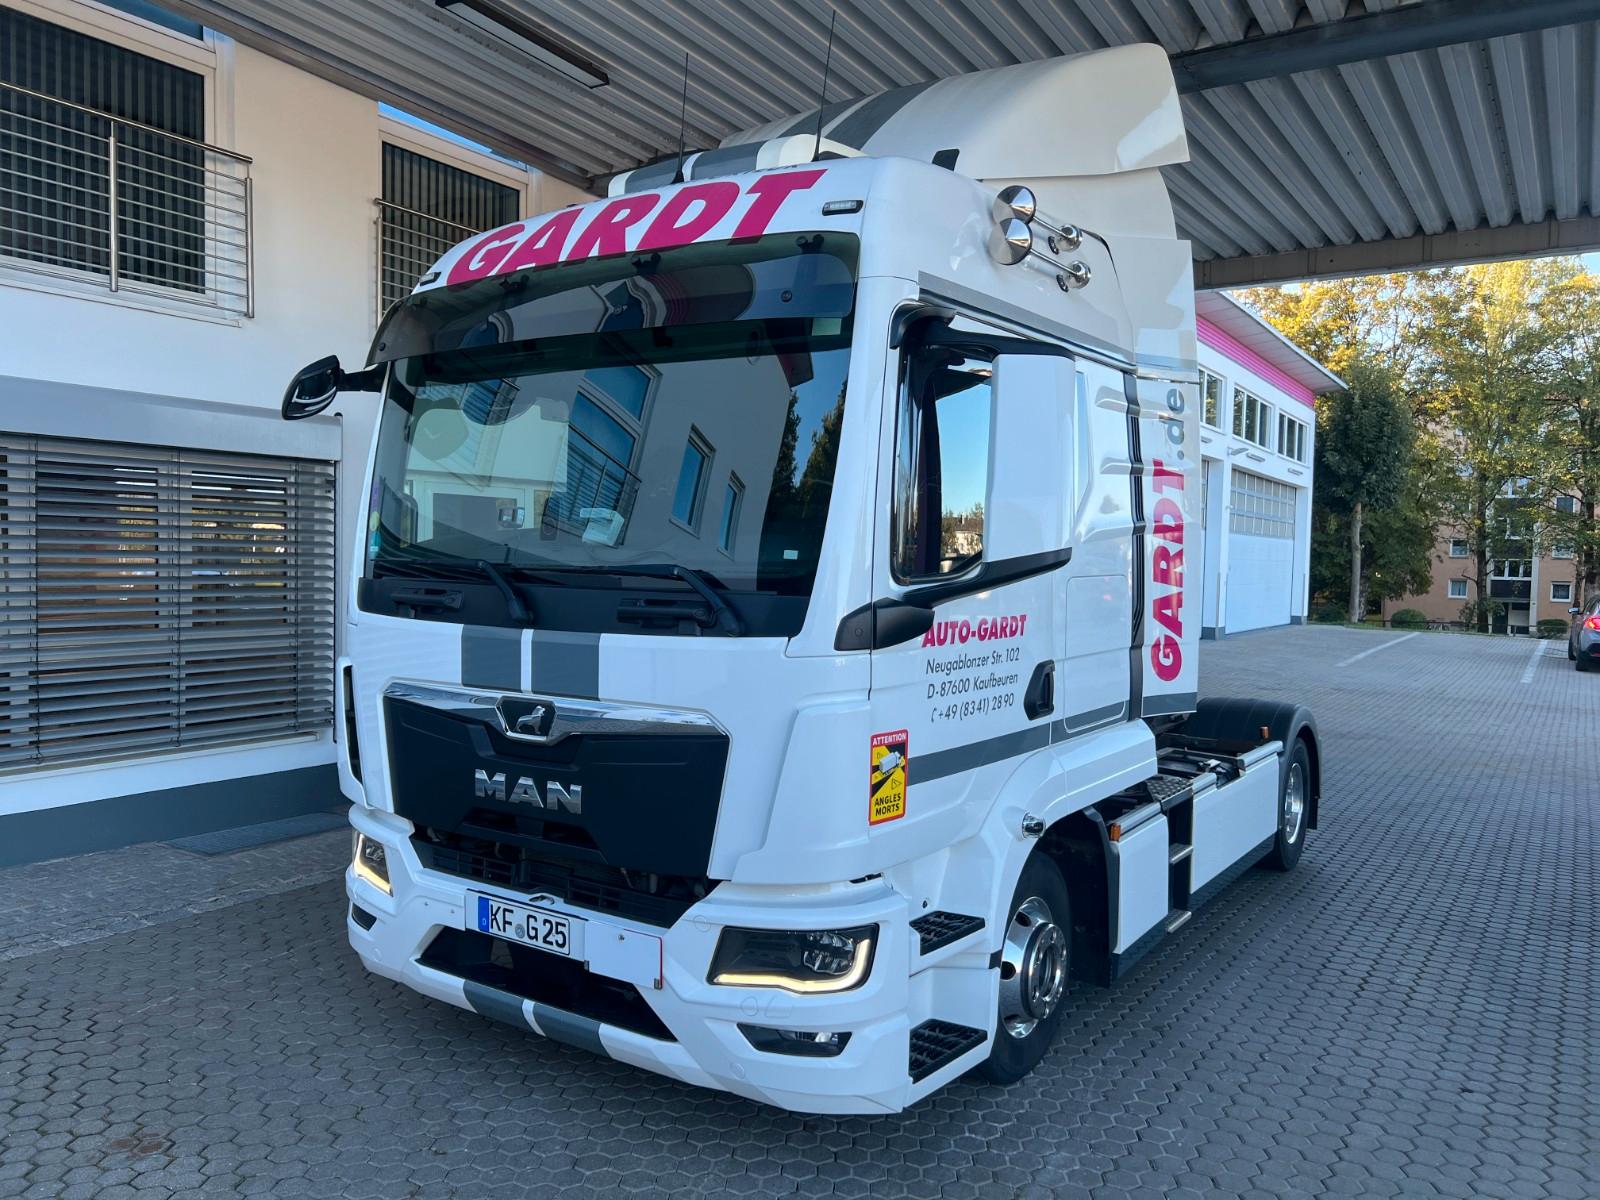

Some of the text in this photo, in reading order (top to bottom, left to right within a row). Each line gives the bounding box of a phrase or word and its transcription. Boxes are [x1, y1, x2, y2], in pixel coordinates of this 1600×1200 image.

[446, 169, 828, 291] GARDT
[921, 614, 1027, 648] AUTO-GARDT
[926, 647, 1020, 676] Neugablonzer Str. 102
[972, 672, 1018, 691] Kaufbeuren
[938, 703, 958, 720] +49
[872, 733, 907, 746] ATTENTION
[474, 768, 582, 814] MAN
[874, 793, 902, 807] ANGLES
[875, 803, 900, 817] MORTS
[490, 904, 514, 933] KF
